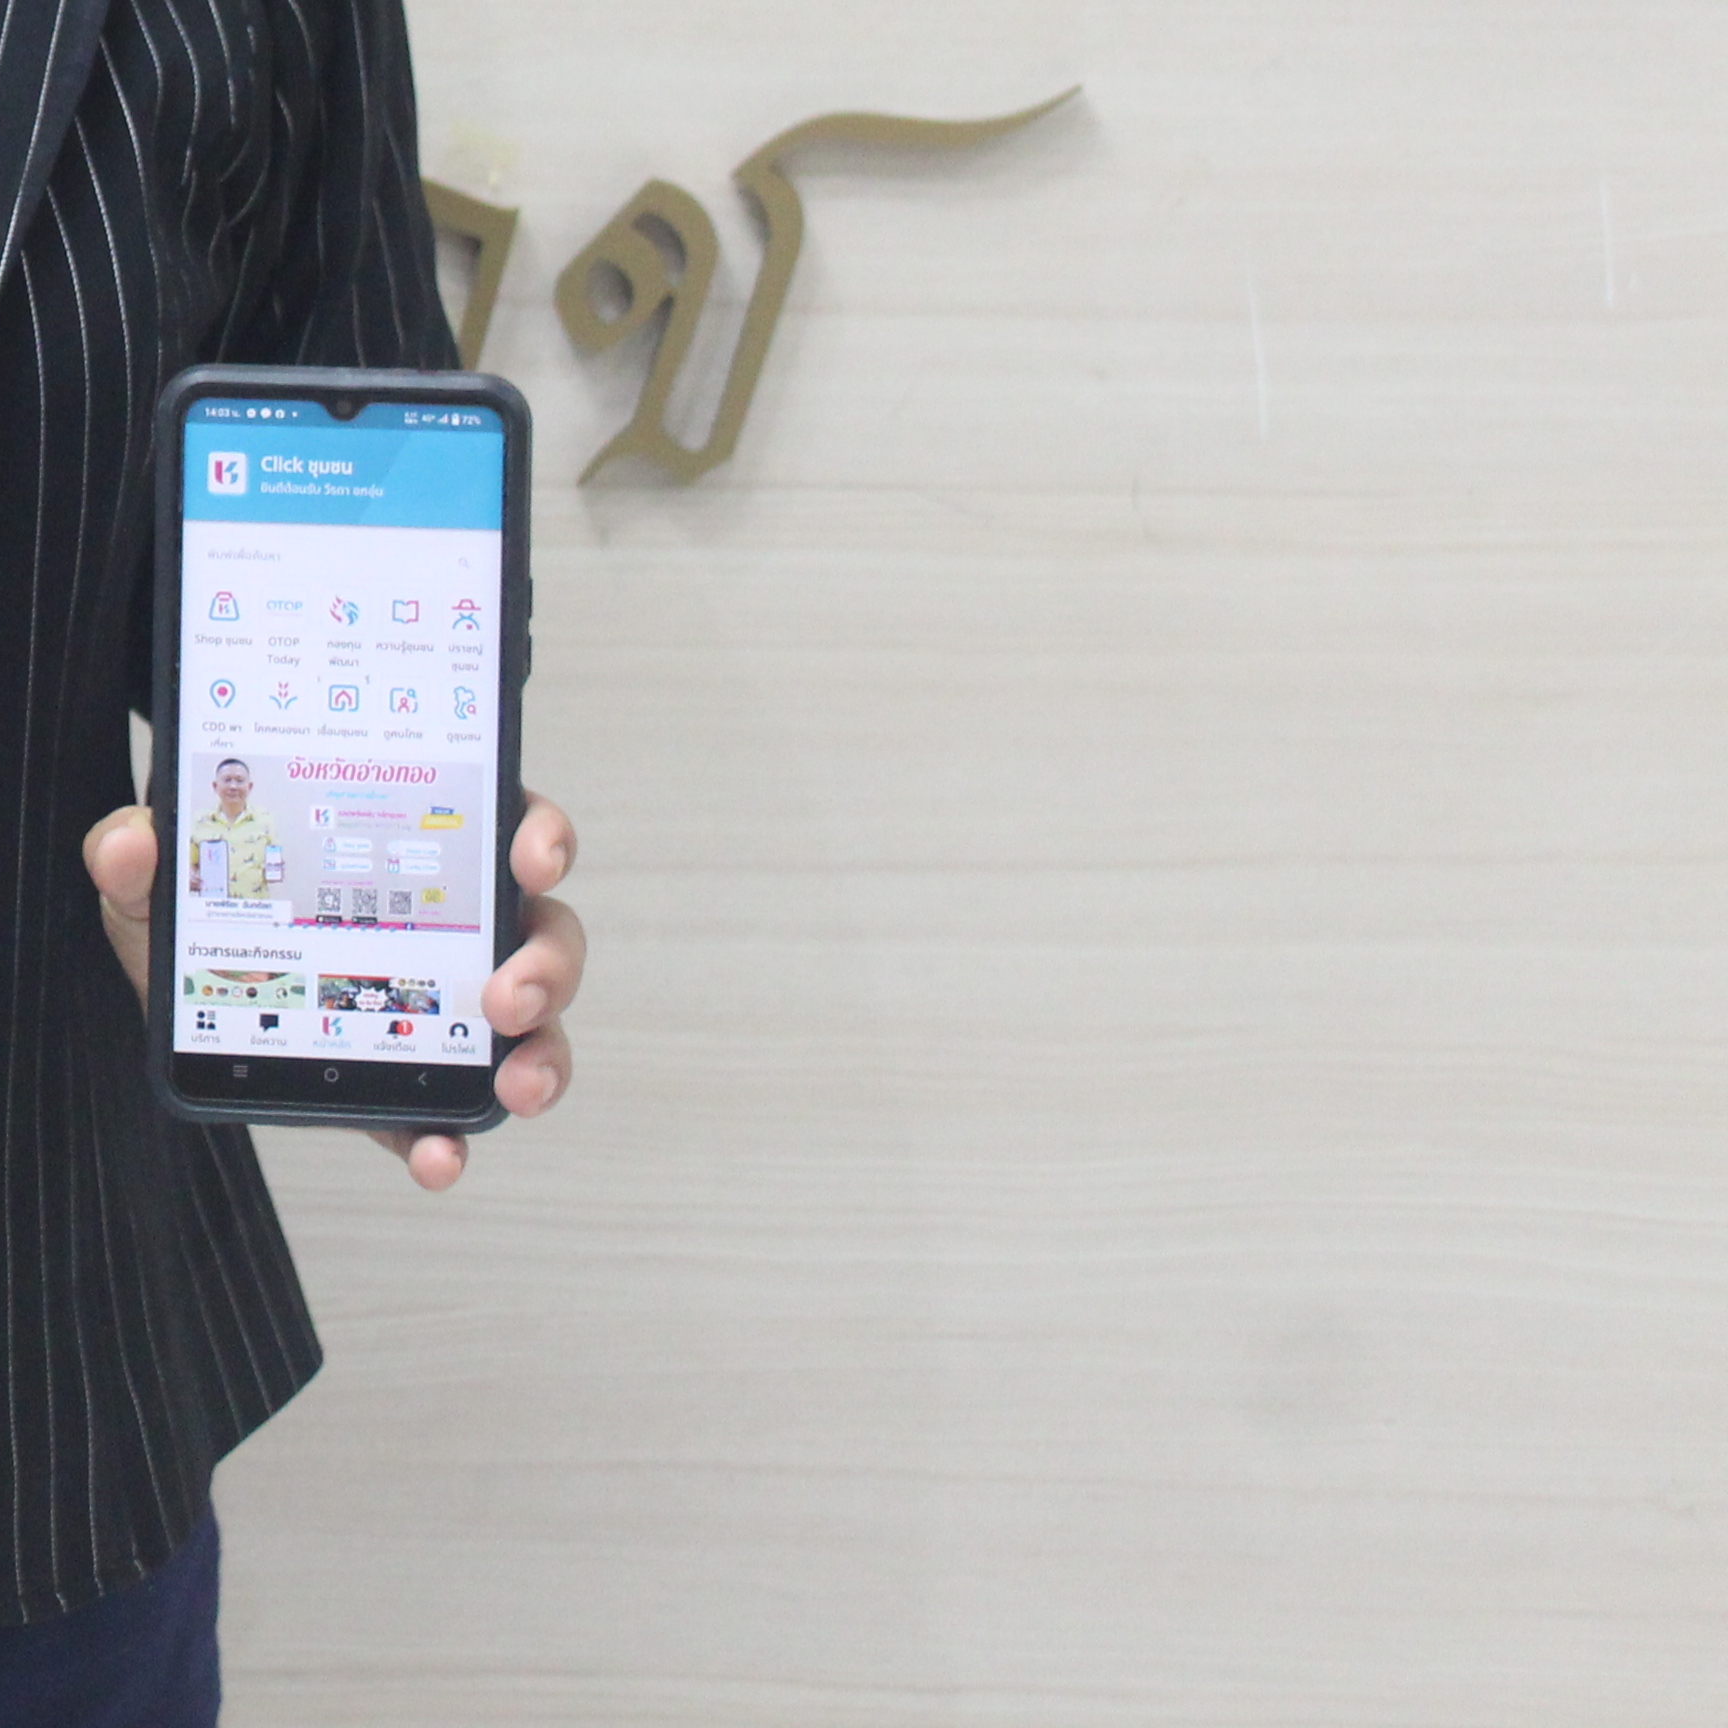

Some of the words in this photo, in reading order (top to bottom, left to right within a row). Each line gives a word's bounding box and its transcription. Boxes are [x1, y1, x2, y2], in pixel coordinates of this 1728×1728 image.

[261, 456, 304, 473] Click
[308, 459, 353, 478] ชุมชน
[195, 635, 222, 647] Shop
[225, 636, 252, 648] ชุมชน
[268, 637, 300, 648] OTOP
[268, 655, 300, 668] Today
[287, 756, 437, 786] จังหวัดอ่างทอง
[188, 944, 302, 962] ข่าวสารและกิจกรรม
[191, 1032, 221, 1045] บริการ
